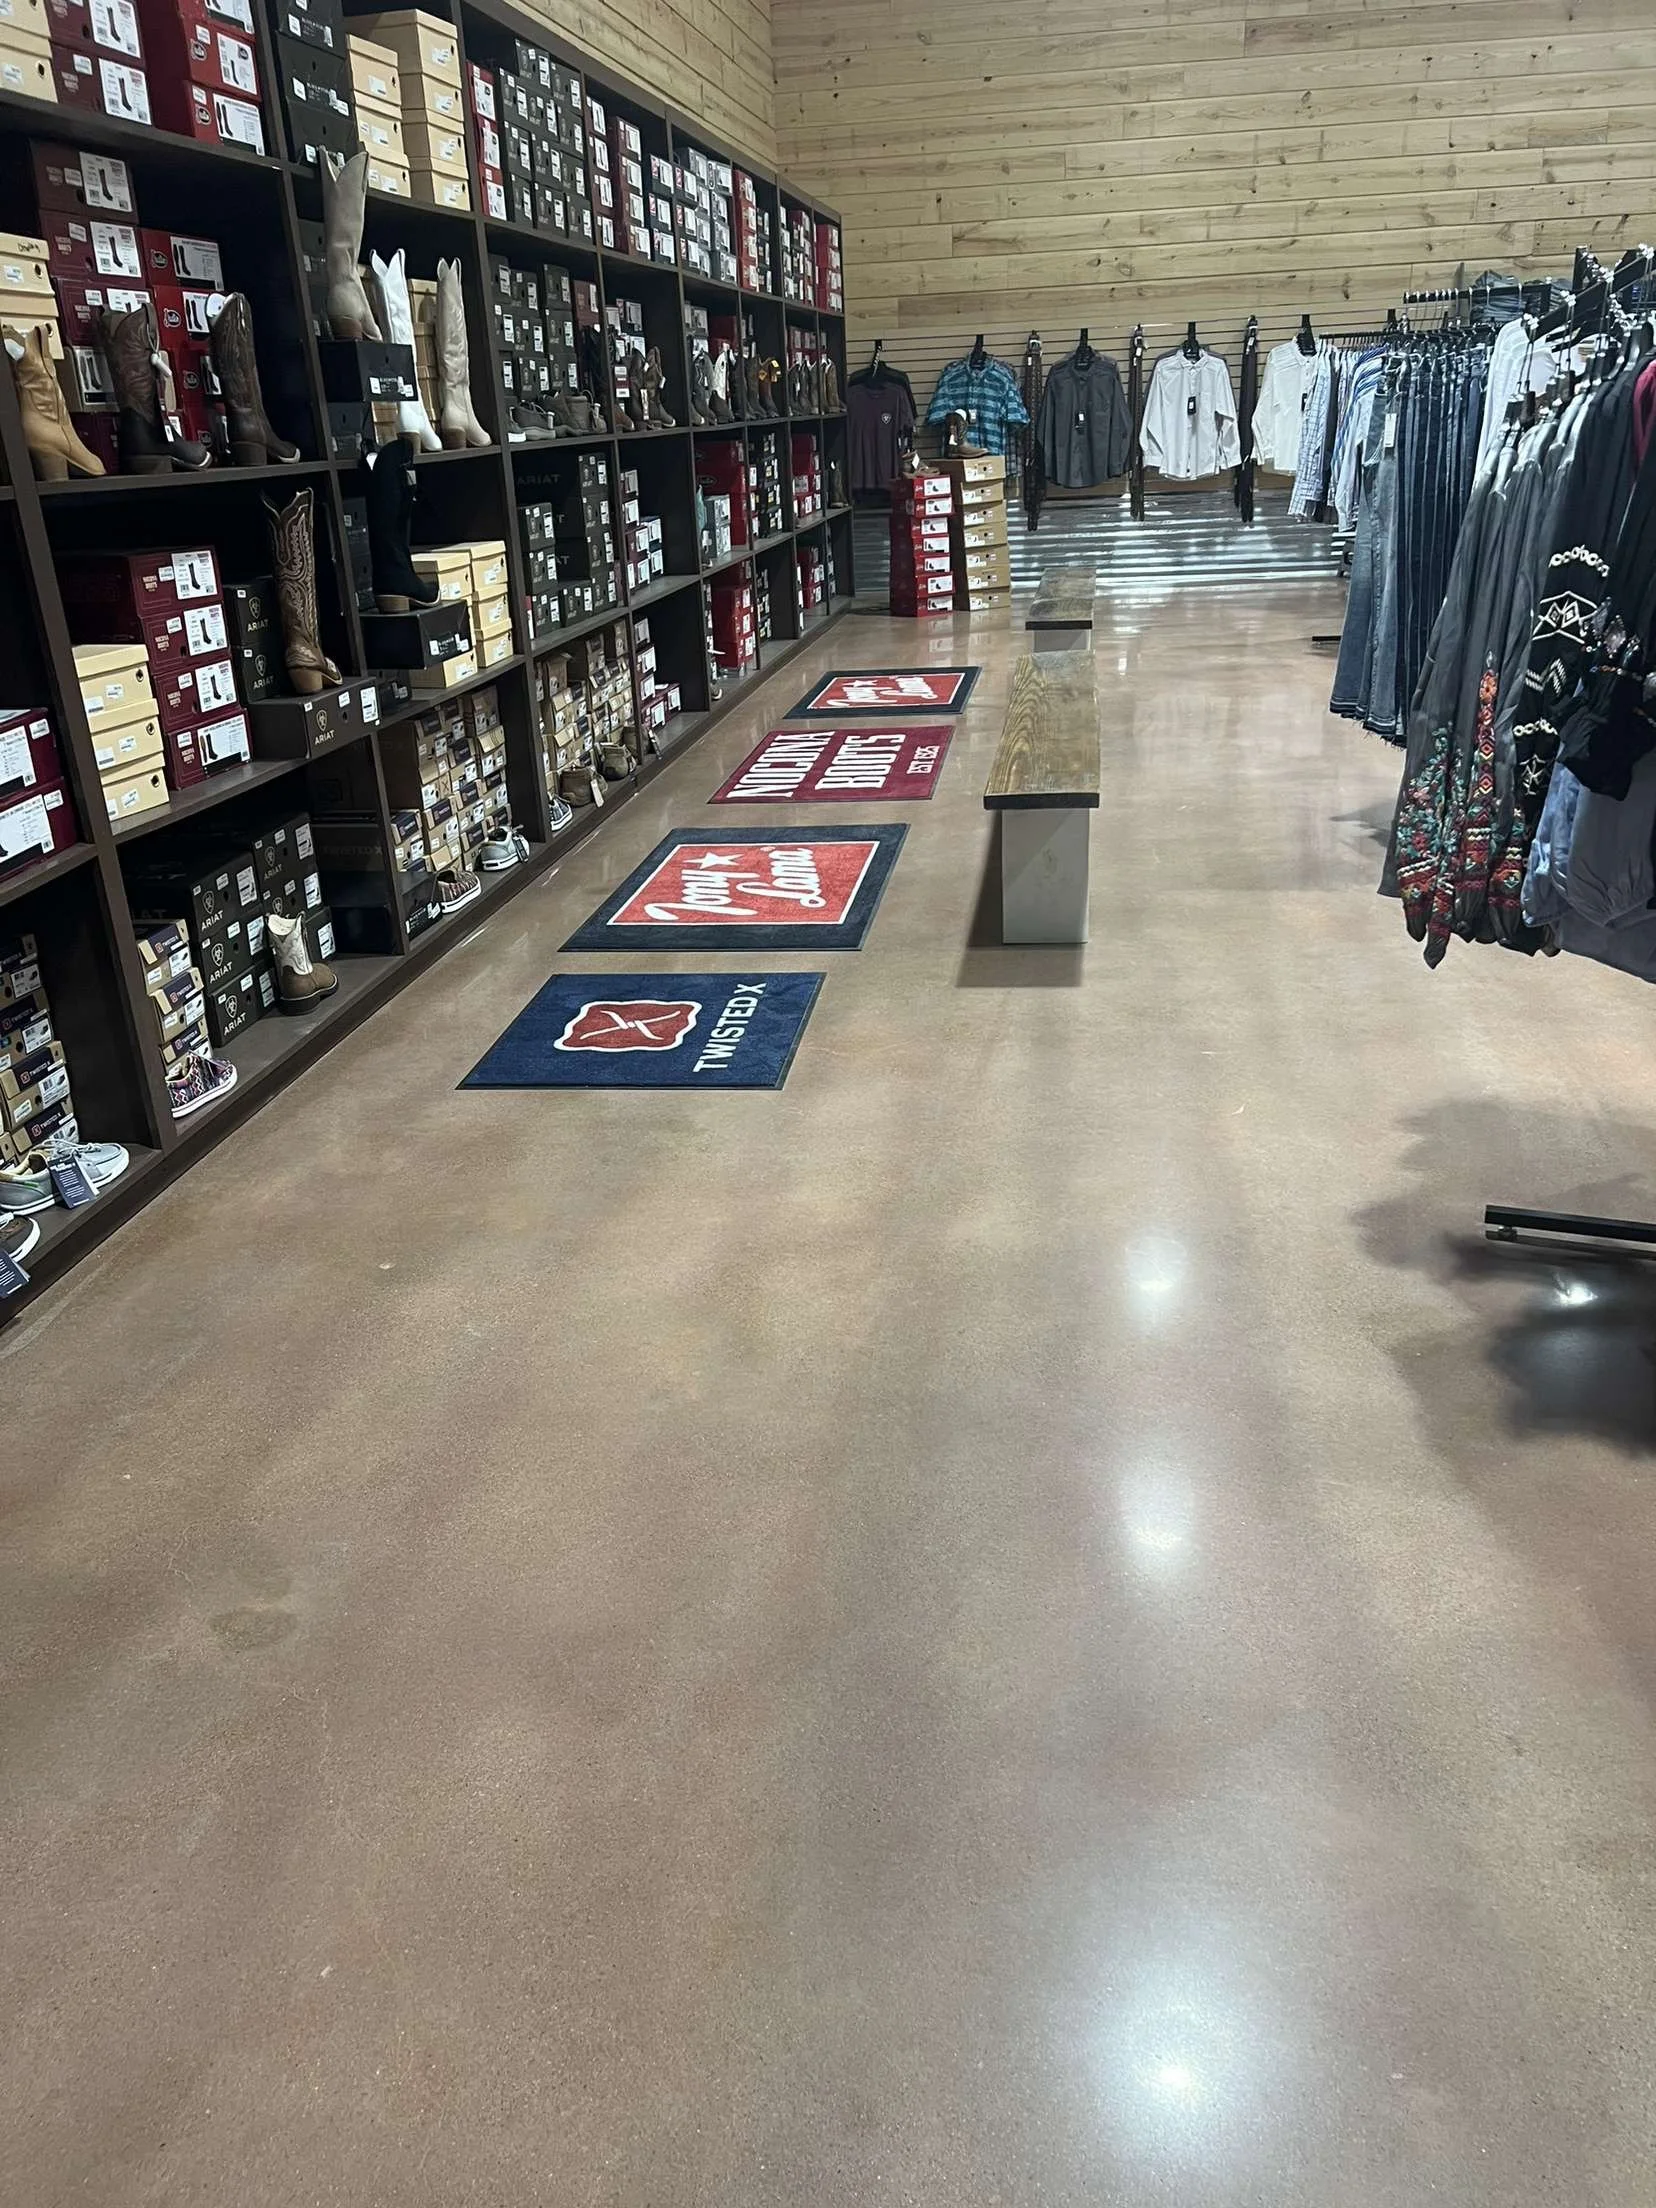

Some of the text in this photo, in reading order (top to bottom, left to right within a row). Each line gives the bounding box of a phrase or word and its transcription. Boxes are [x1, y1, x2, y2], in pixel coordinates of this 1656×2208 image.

[247, 619, 269, 632] ARIAT
[253, 676, 274, 690] ARIAT
[315, 729, 336, 745] ARIAT
[726, 731, 836, 798] NOCONA
[815, 734, 906, 790] BOOTS
[263, 864, 283, 880] ARIAT
[736, 848, 827, 908] Lama
[644, 869, 761, 921] Tony
[201, 911, 224, 932] ARIAT
[209, 962, 233, 984] ARIAT
[223, 1012, 247, 1036] ARIAT
